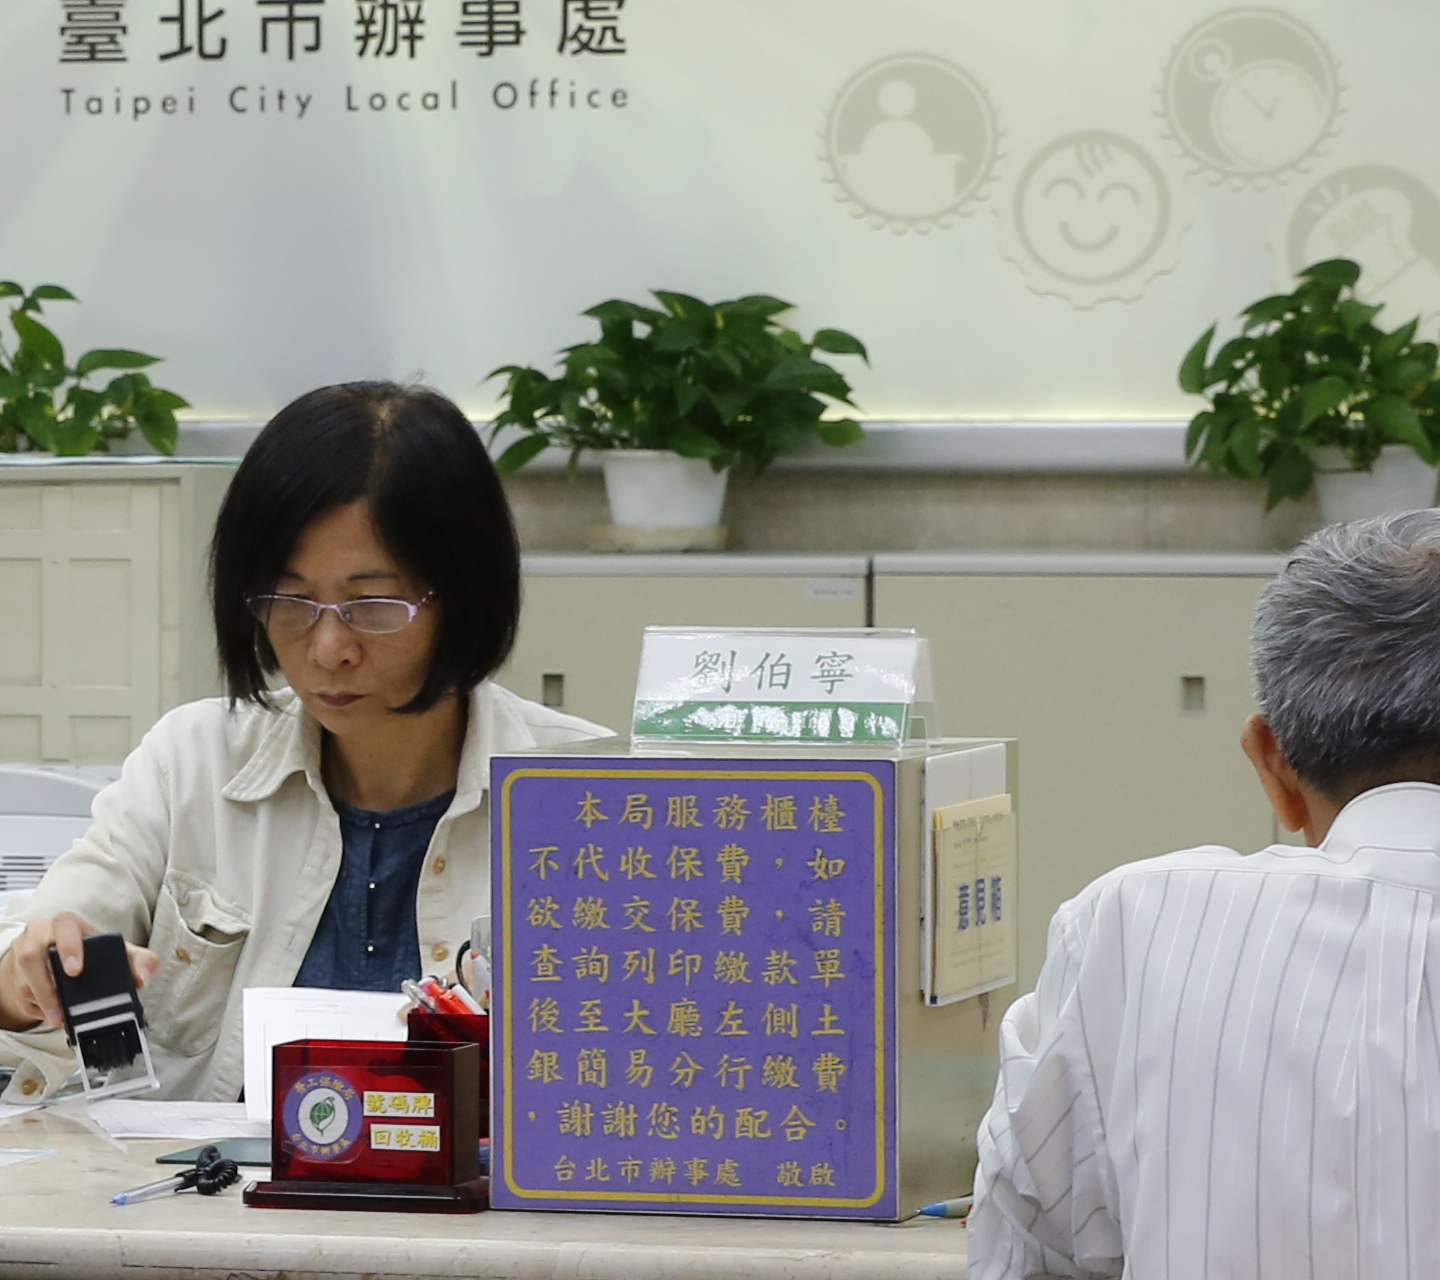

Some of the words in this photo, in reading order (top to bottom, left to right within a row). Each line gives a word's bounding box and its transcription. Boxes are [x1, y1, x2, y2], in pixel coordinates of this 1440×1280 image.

[60, 85, 197, 121] Taipei
[229, 84, 314, 119] City
[346, 81, 458, 113] Local
[492, 77, 629, 110] Office
[692, 650, 855, 695] 劉伯寧
[573, 791, 847, 833] 本局服務櫃檯
[527, 843, 846, 884] 不代收保費，如
[526, 894, 847, 937] 欲繳交保費，請
[529, 943, 847, 988] 查詢列印繳款單
[527, 997, 847, 1038] 後至大廳左側土
[526, 1048, 847, 1093] 銀簡易分行繳費
[776, 1160, 837, 1187] 敬啟
